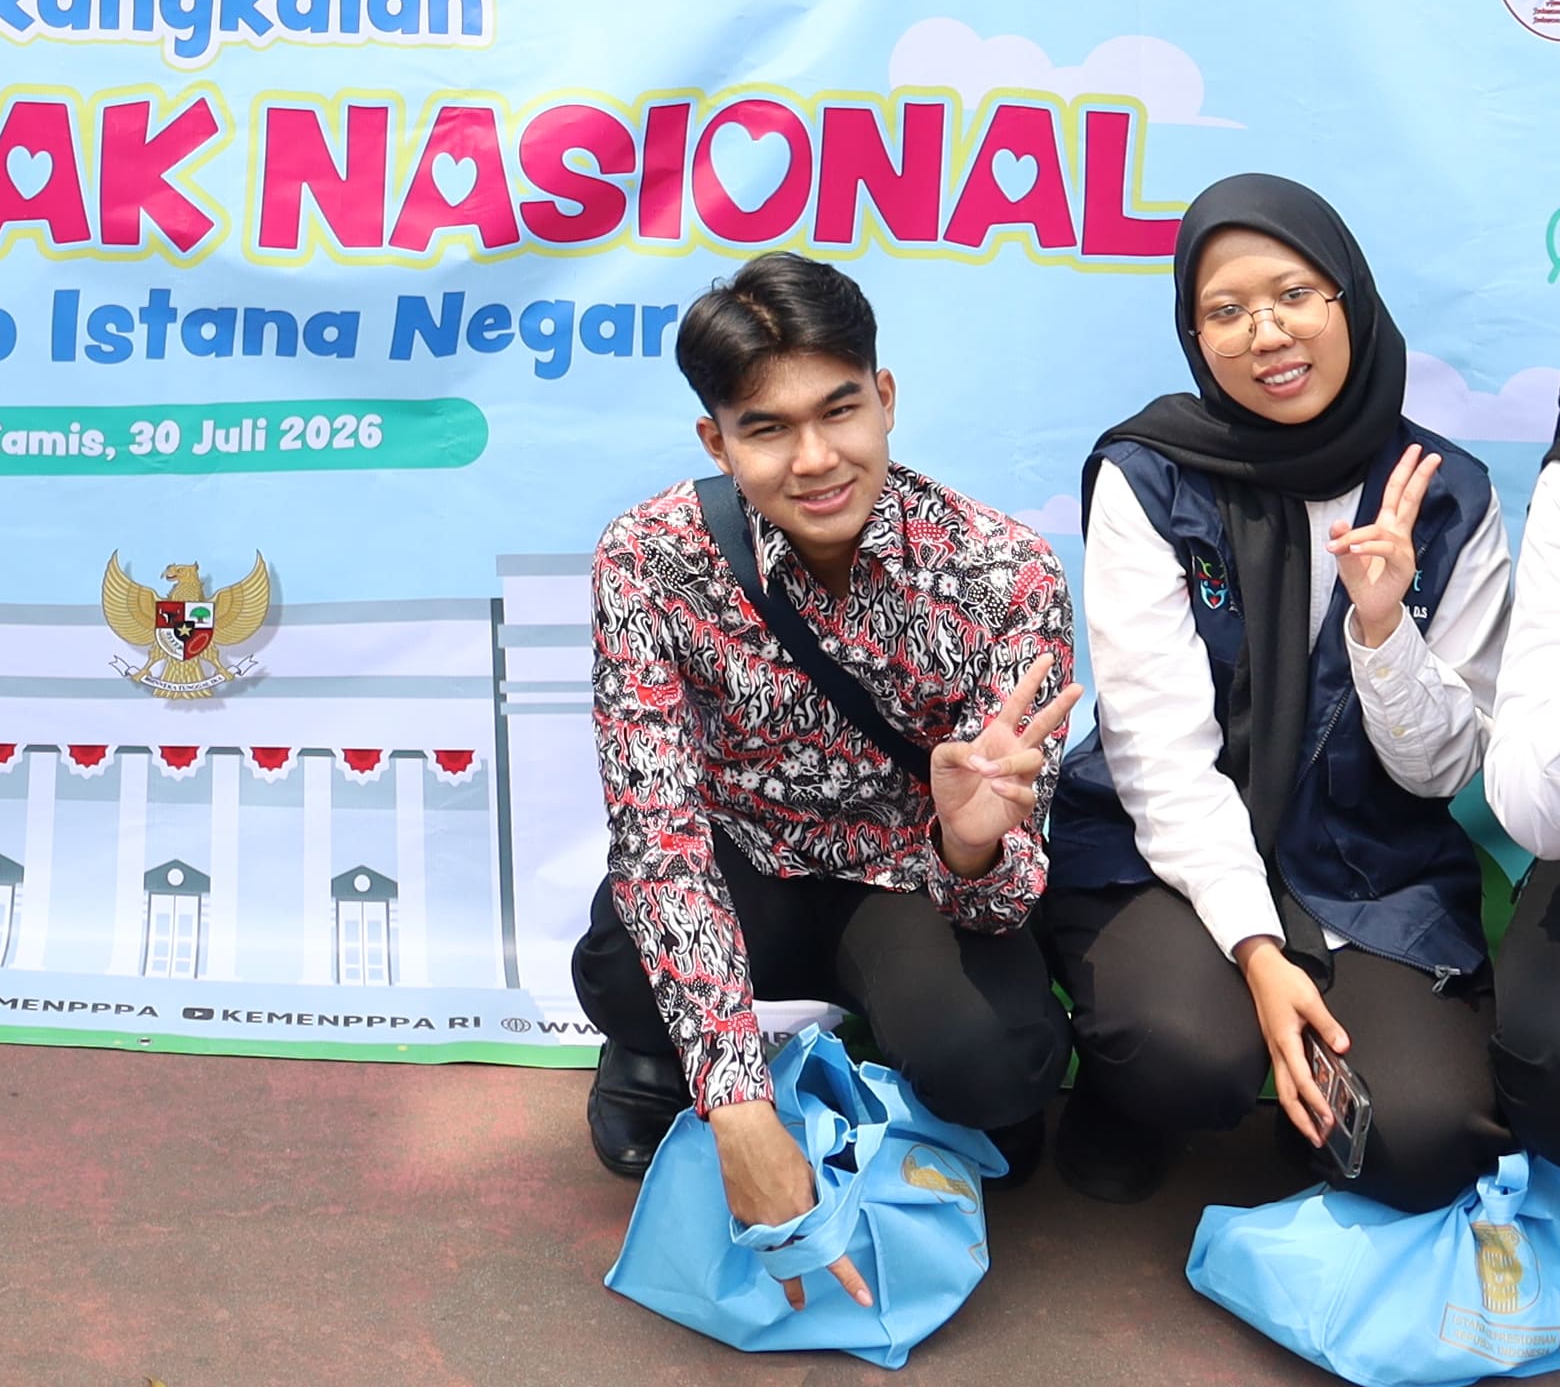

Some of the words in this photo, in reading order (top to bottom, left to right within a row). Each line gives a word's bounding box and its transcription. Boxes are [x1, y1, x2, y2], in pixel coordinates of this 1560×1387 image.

[258, 98, 1178, 257] NASIONAL
[51, 285, 359, 365] Istana
[389, 288, 680, 380] Negar
[128, 419, 181, 456] 30
[192, 416, 269, 455] Juli
[279, 413, 383, 453] 2026
[221, 1008, 435, 1031] KEMENPPPA
[447, 1015, 482, 1031] RI
